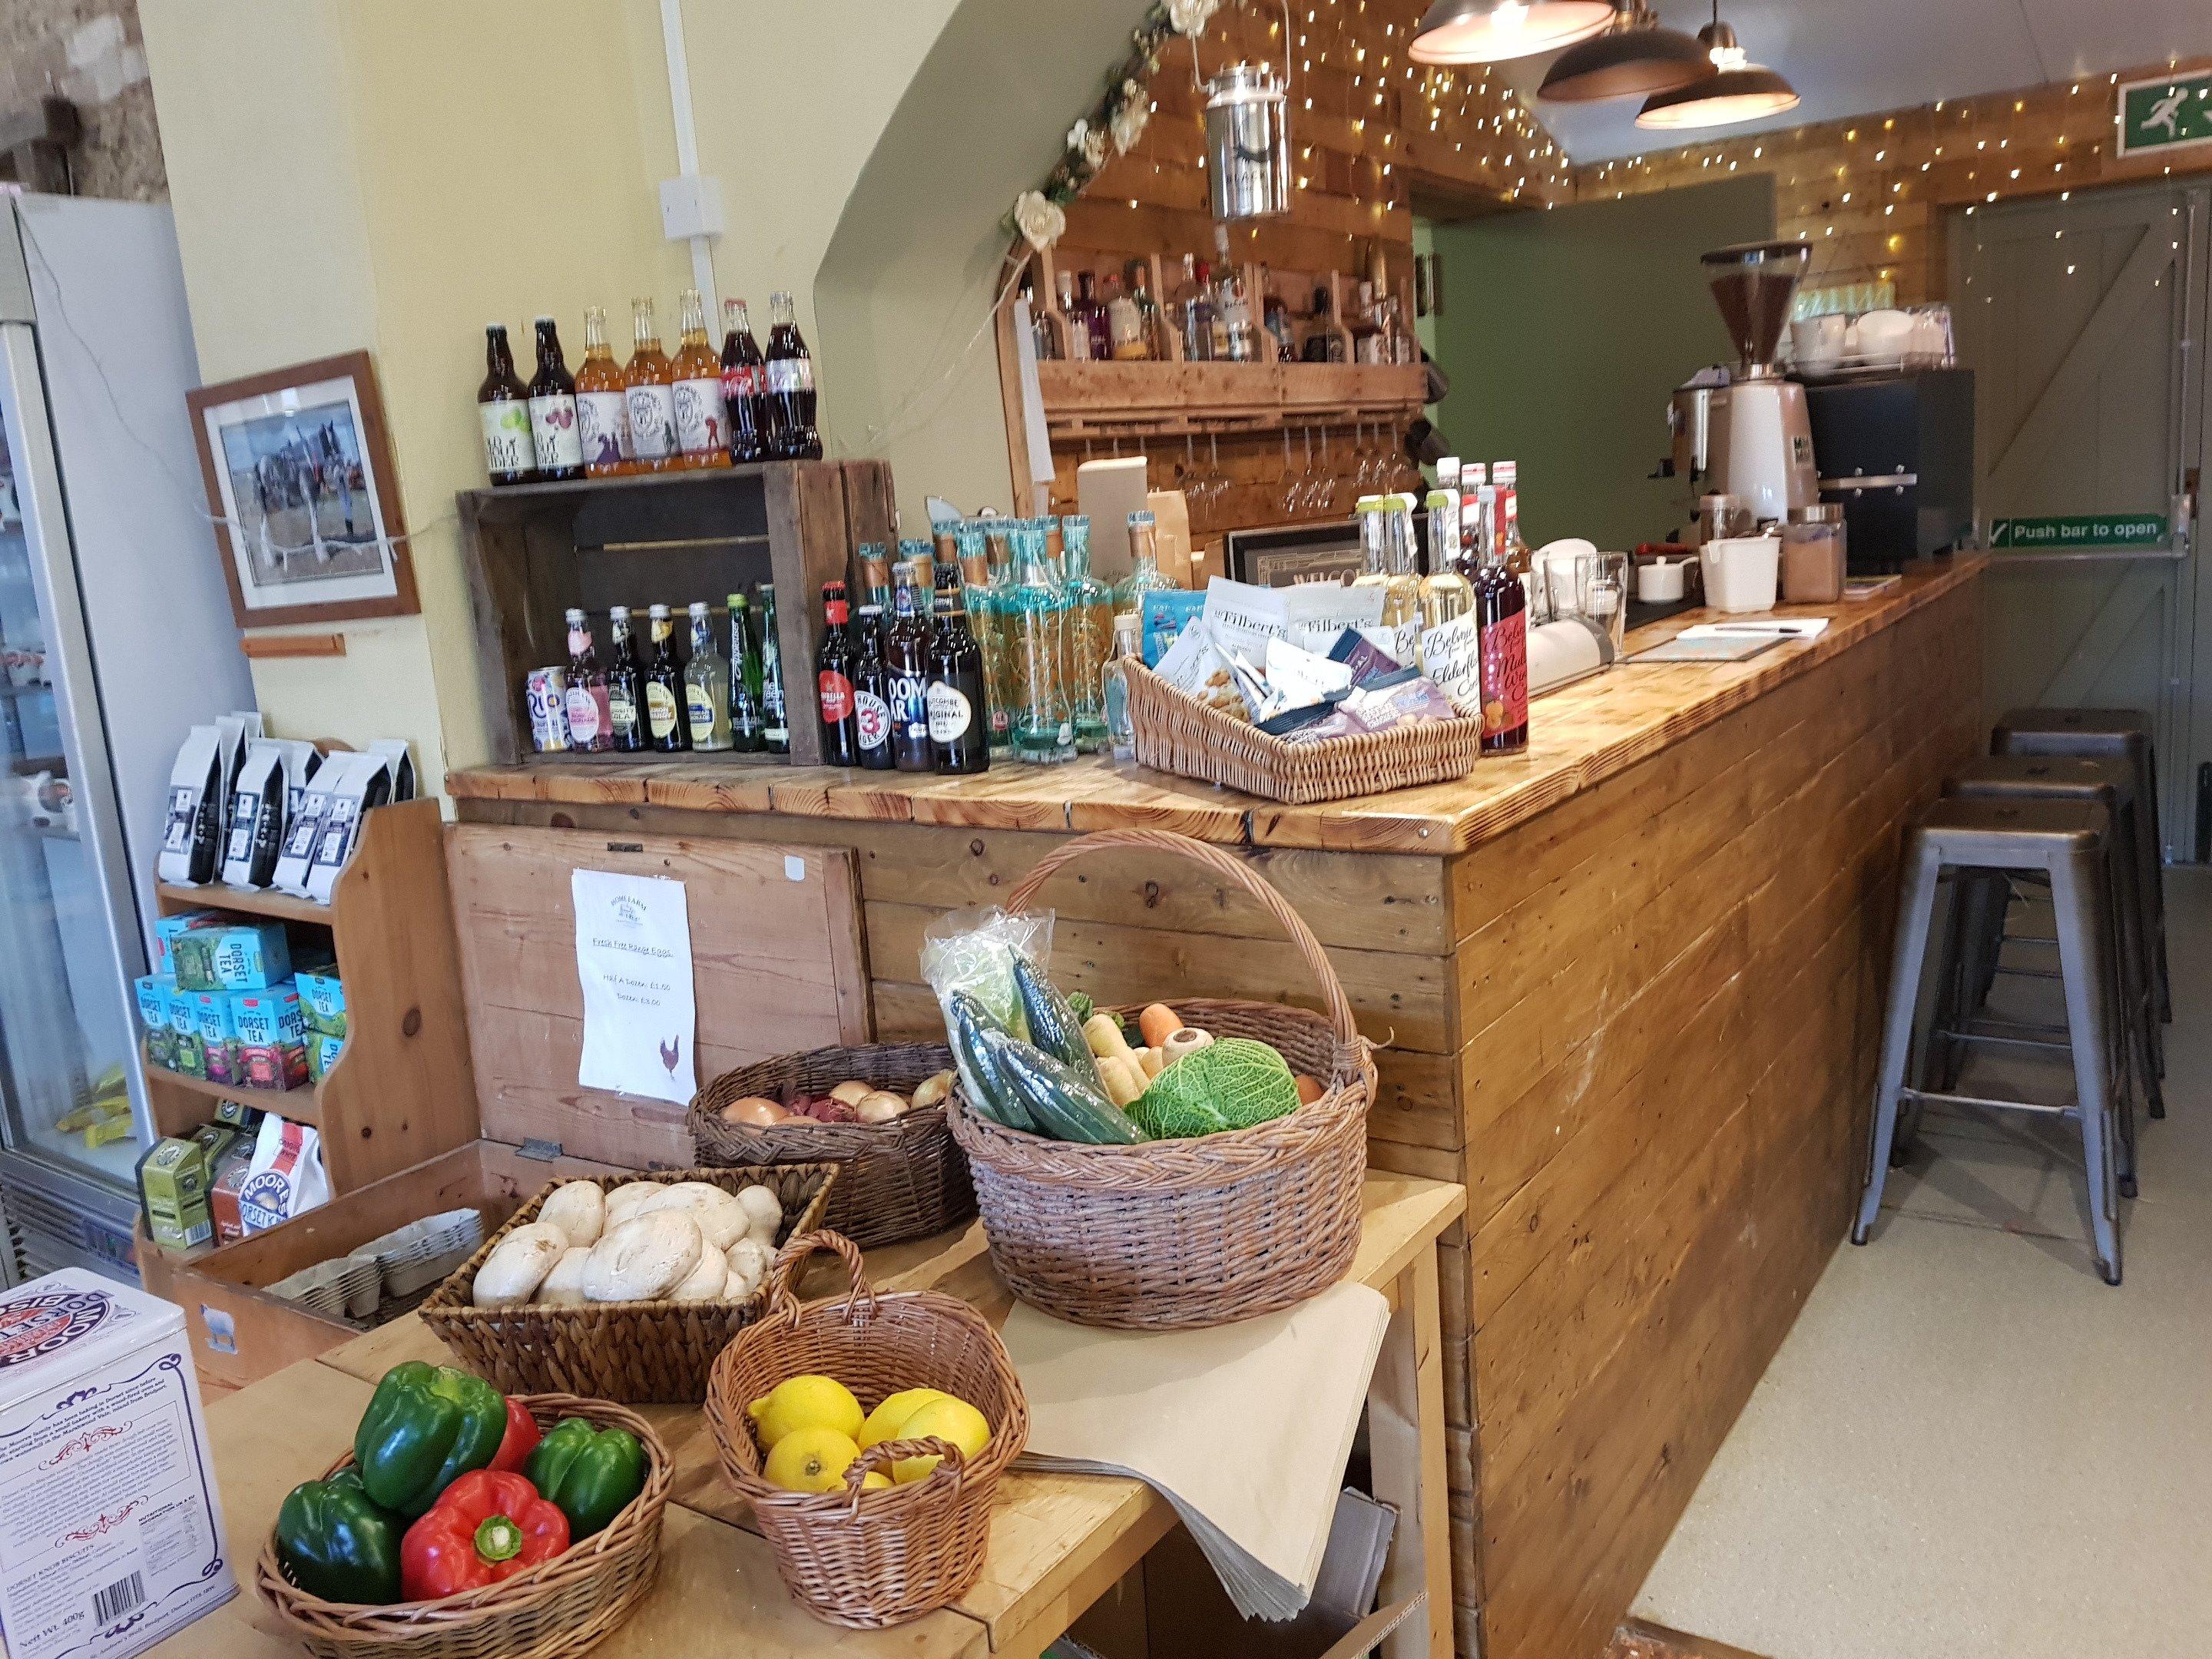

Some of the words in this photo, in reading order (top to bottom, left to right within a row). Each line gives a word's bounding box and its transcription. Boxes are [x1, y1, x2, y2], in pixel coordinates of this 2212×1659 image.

[2014, 525, 2056, 538] Push
[2061, 525, 2087, 538] bar
[2093, 523, 2108, 536] to
[2114, 523, 2157, 538] open
[1224, 611, 1287, 641] Filbert's
[1307, 618, 1372, 633] Filbert's
[889, 677, 926, 702] OOM
[891, 700, 910, 721] AR
[218, 954, 232, 974] TEA
[230, 943, 248, 983] DORSET
[311, 988, 333, 1005] DORSET
[141, 998, 162, 1013] DORSET
[168, 1001, 191, 1018] DORSET
[318, 1002, 330, 1013] TEA
[147, 1012, 159, 1024] TEA
[175, 1016, 187, 1031] TEA
[197, 1011, 221, 1027] DORSET
[237, 1015, 270, 1030] DORSET
[278, 1010, 303, 1028] DORS
[204, 1025, 218, 1038] TEA
[247, 1029, 264, 1043] TEA
[244, 1174, 290, 1215] MOORES
[79, 1404, 97, 1415] baking
[106, 1392, 123, 1402] Dorset
[34, 1433, 47, 1442] from
[71, 1414, 90, 1424] bakery
[111, 1391, 139, 1406] wood-fired
[61, 1609, 86, 1627] 400g
